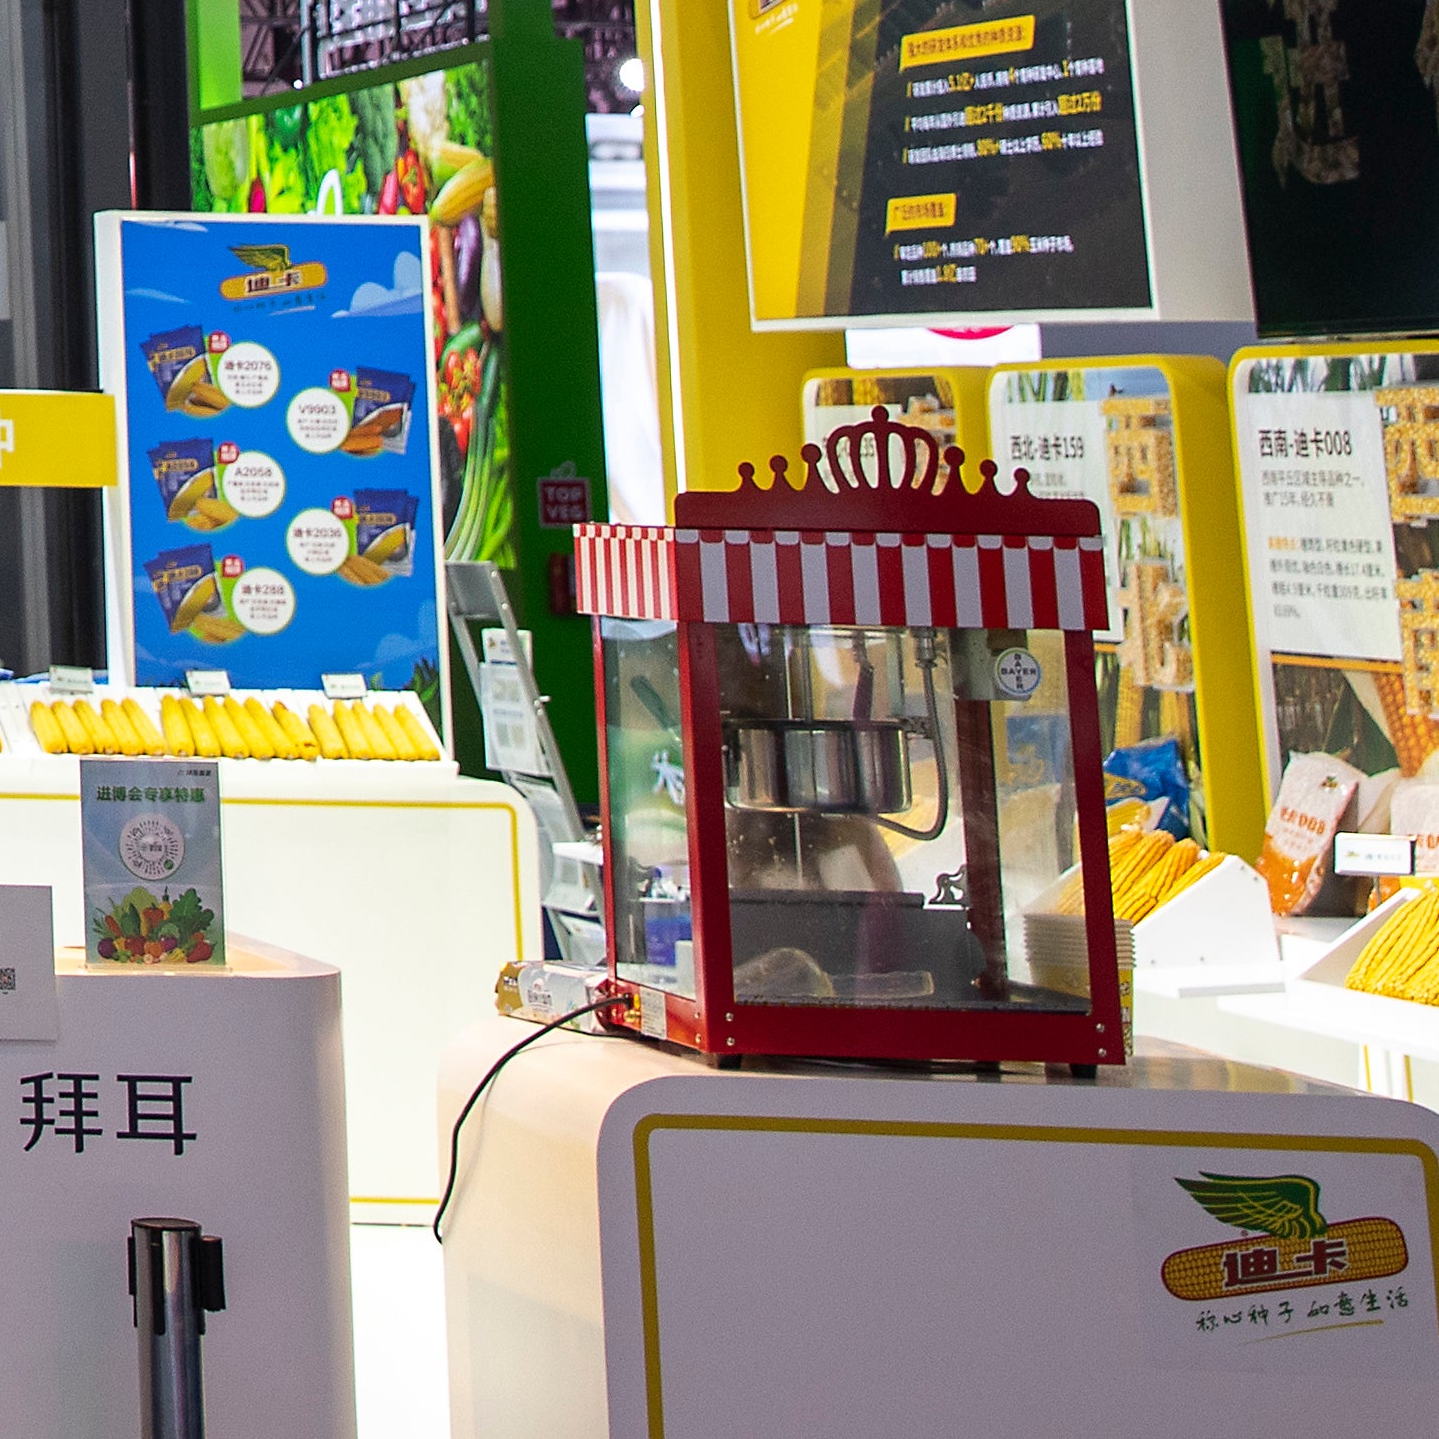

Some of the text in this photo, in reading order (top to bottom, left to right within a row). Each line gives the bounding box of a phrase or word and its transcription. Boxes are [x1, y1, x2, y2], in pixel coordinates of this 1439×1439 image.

[19, 1071, 197, 1157] 拜耳
[1222, 1239, 1349, 1290] 迪卡
[1307, 1285, 1411, 1319] 如意生活
